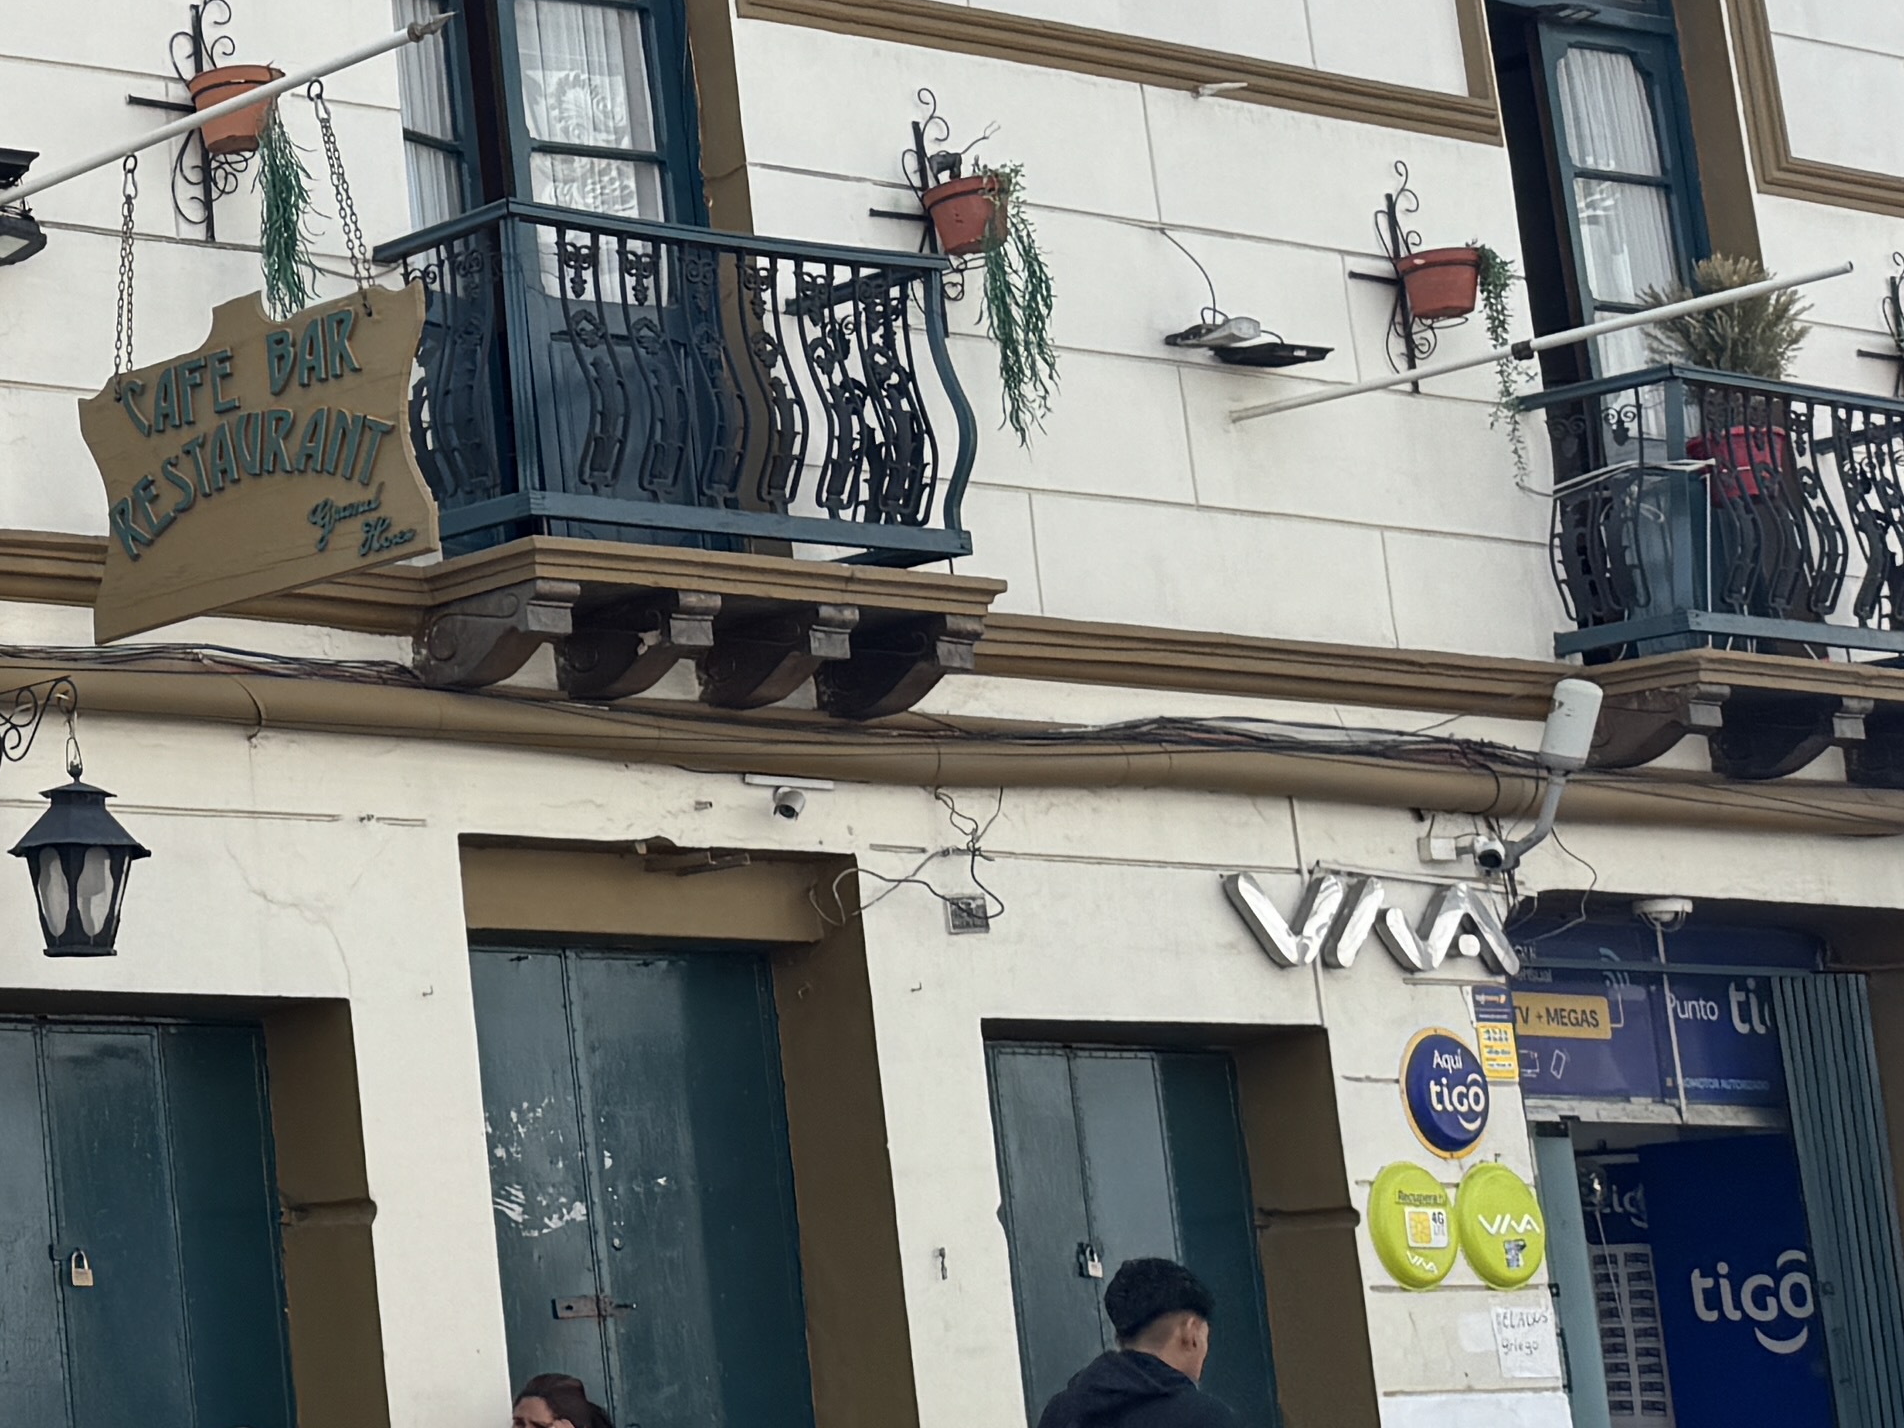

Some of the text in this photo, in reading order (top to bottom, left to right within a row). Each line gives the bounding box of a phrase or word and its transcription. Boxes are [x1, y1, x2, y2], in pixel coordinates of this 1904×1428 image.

[122, 307, 362, 437] CAFE BAR
[109, 406, 395, 562] RESTAURANT
[1667, 992, 1719, 1022] Punto
[1429, 1073, 1485, 1132] tigo
[1691, 1249, 1815, 1354] tigo
